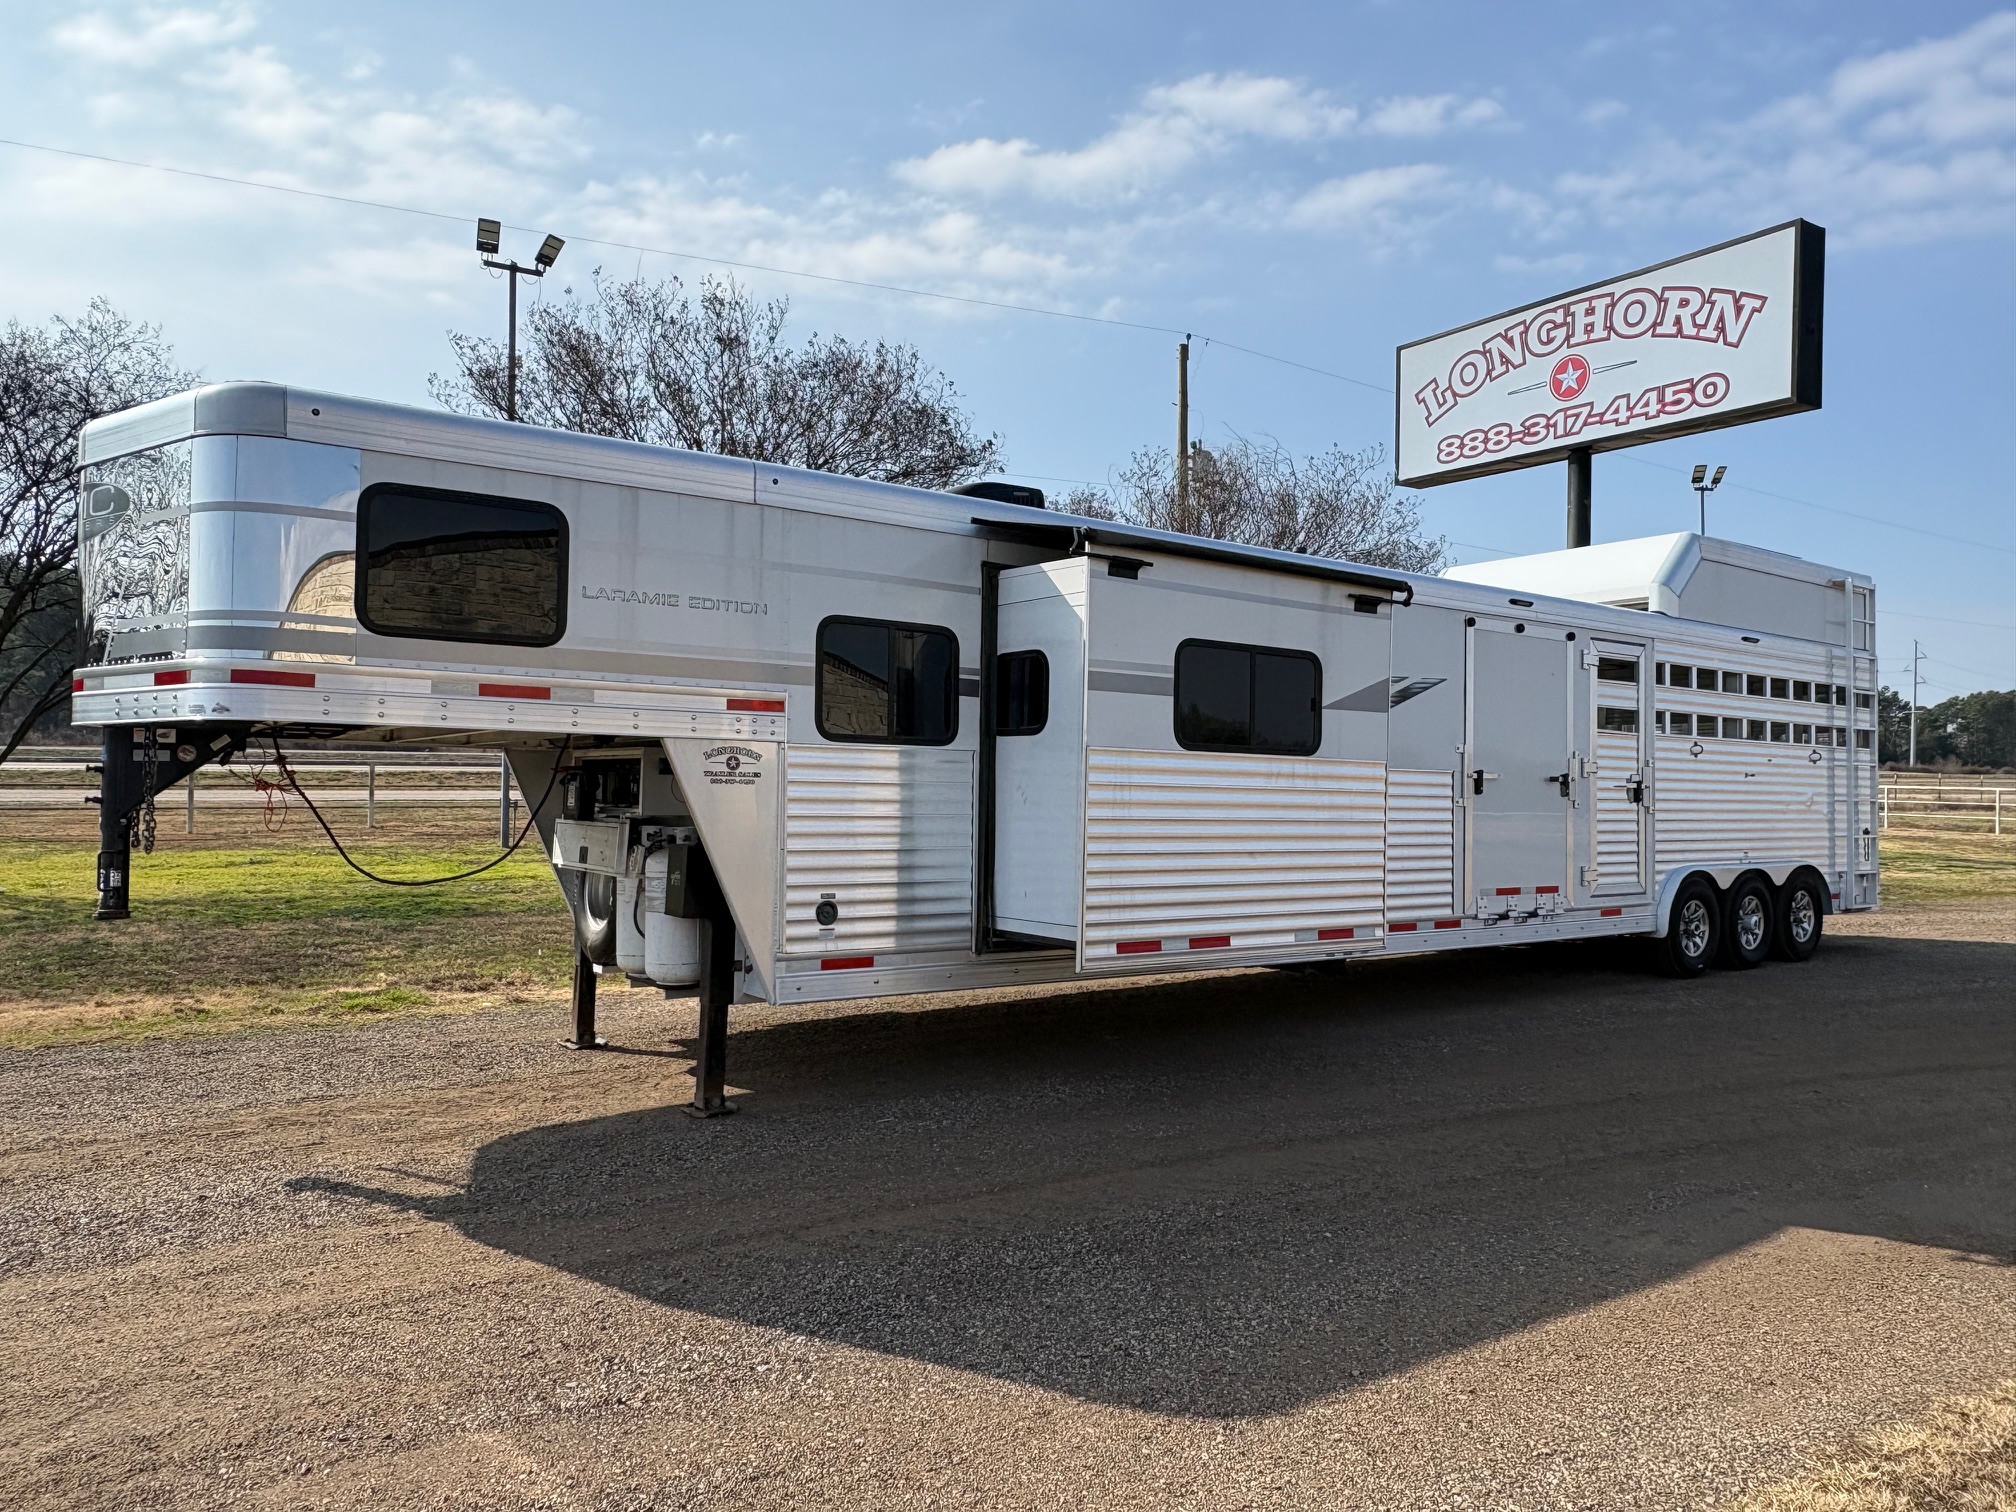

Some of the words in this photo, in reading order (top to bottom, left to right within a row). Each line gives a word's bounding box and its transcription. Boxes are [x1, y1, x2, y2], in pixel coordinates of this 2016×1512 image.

[1415, 286, 1768, 427] LONGHORN
[1437, 372, 1730, 464] 888-317-4450
[582, 586, 680, 607] LARAMIE
[688, 596, 768, 615] EDITION
